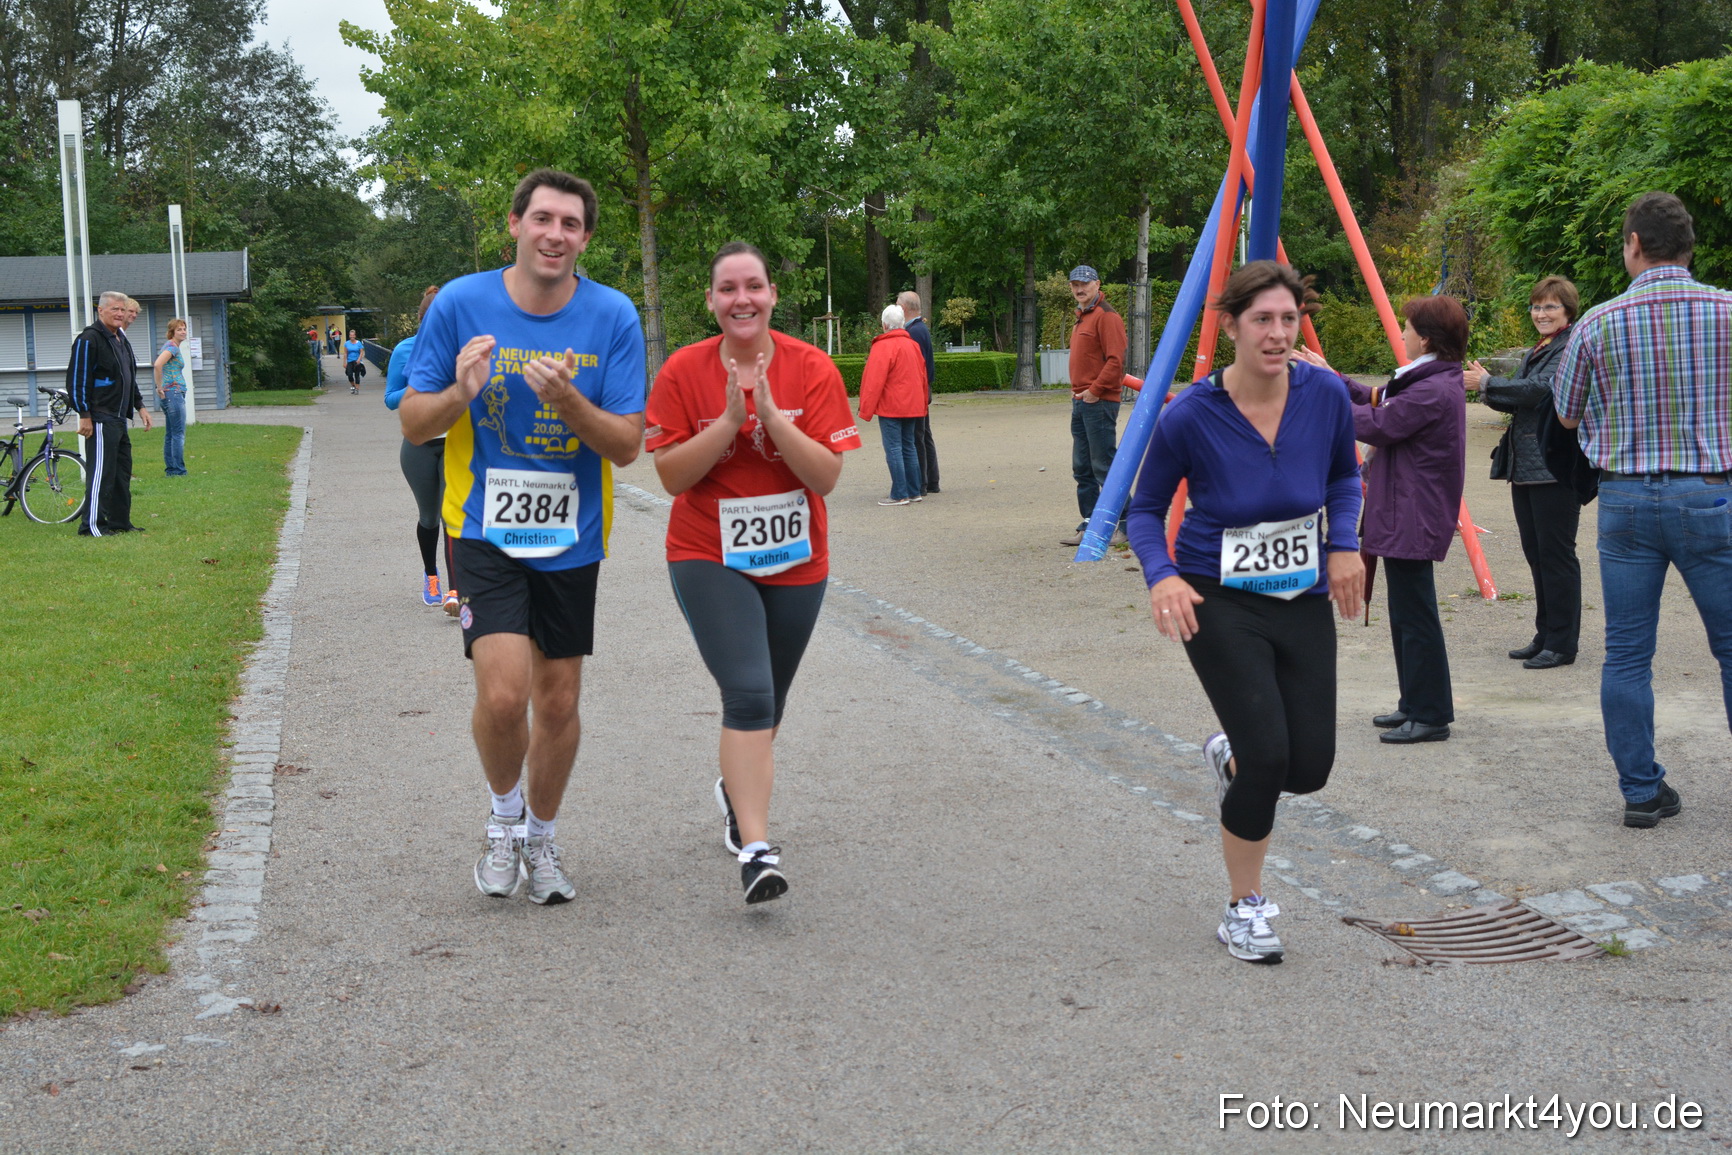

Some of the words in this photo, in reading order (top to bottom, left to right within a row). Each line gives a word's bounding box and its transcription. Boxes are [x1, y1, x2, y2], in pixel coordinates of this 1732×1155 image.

[499, 347, 599, 368] NEUMARTER
[488, 477, 520, 488] PARTL
[522, 478, 566, 490] Neumarkt
[494, 491, 570, 524] 2384
[721, 505, 751, 515] PARTL
[754, 500, 795, 514] Neumarkt
[731, 510, 802, 547] 2306
[1225, 530, 1255, 540] PARTL
[503, 531, 557, 545] Christian
[749, 550, 790, 567] Kathrin
[1233, 535, 1309, 573] 2385
[1241, 576, 1299, 592] Michaela
